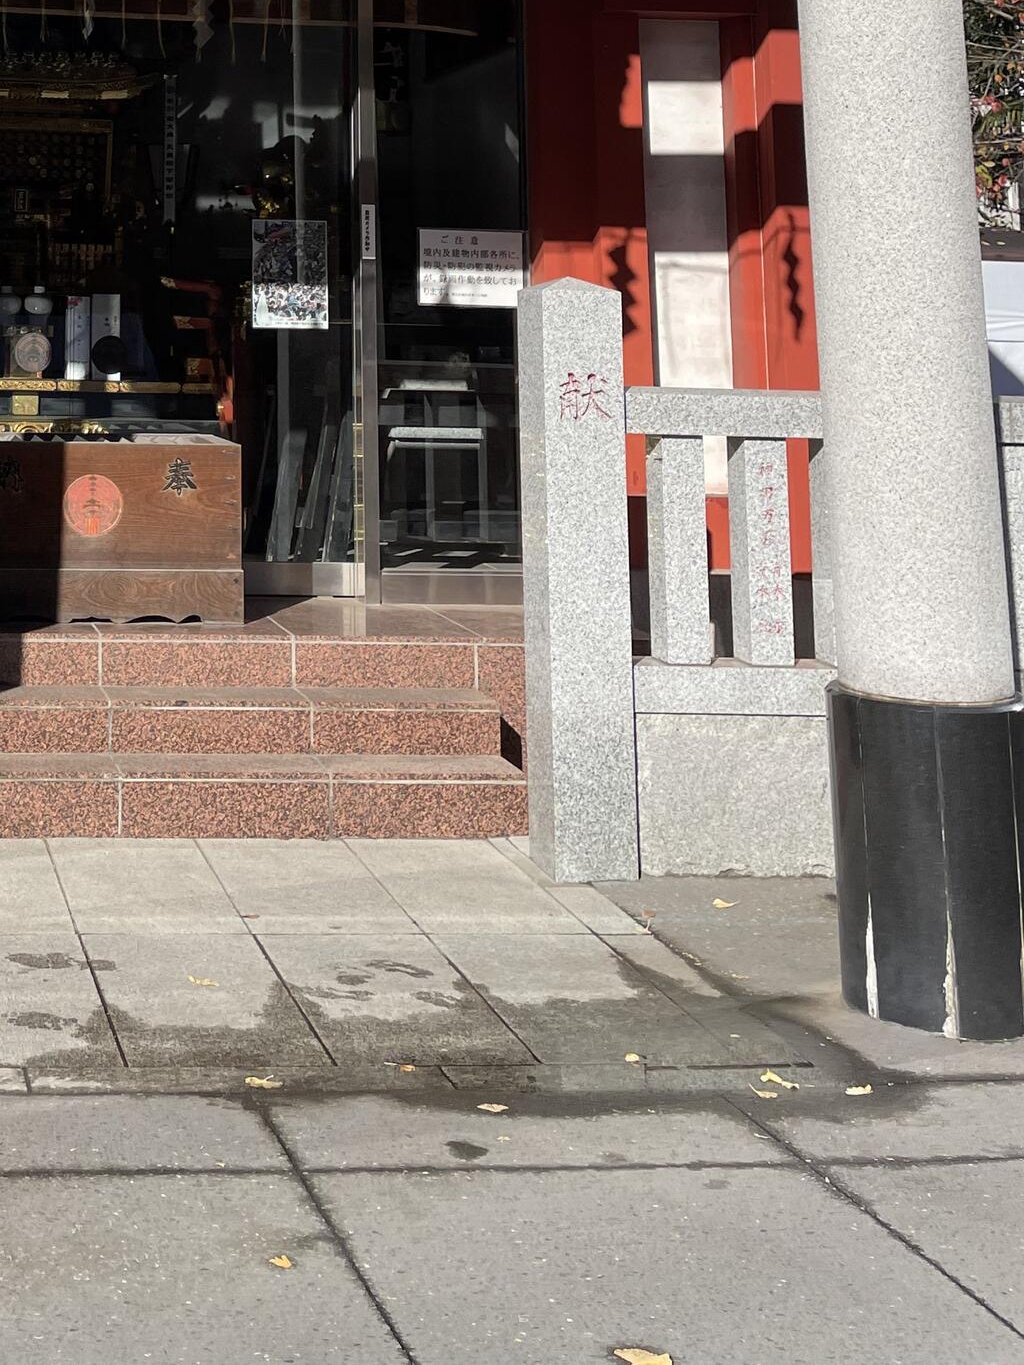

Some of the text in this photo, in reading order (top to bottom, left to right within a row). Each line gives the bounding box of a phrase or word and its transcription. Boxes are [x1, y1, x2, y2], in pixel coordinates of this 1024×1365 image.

[440, 235, 478, 245] ご注意
[162, 458, 197, 495] 奉
